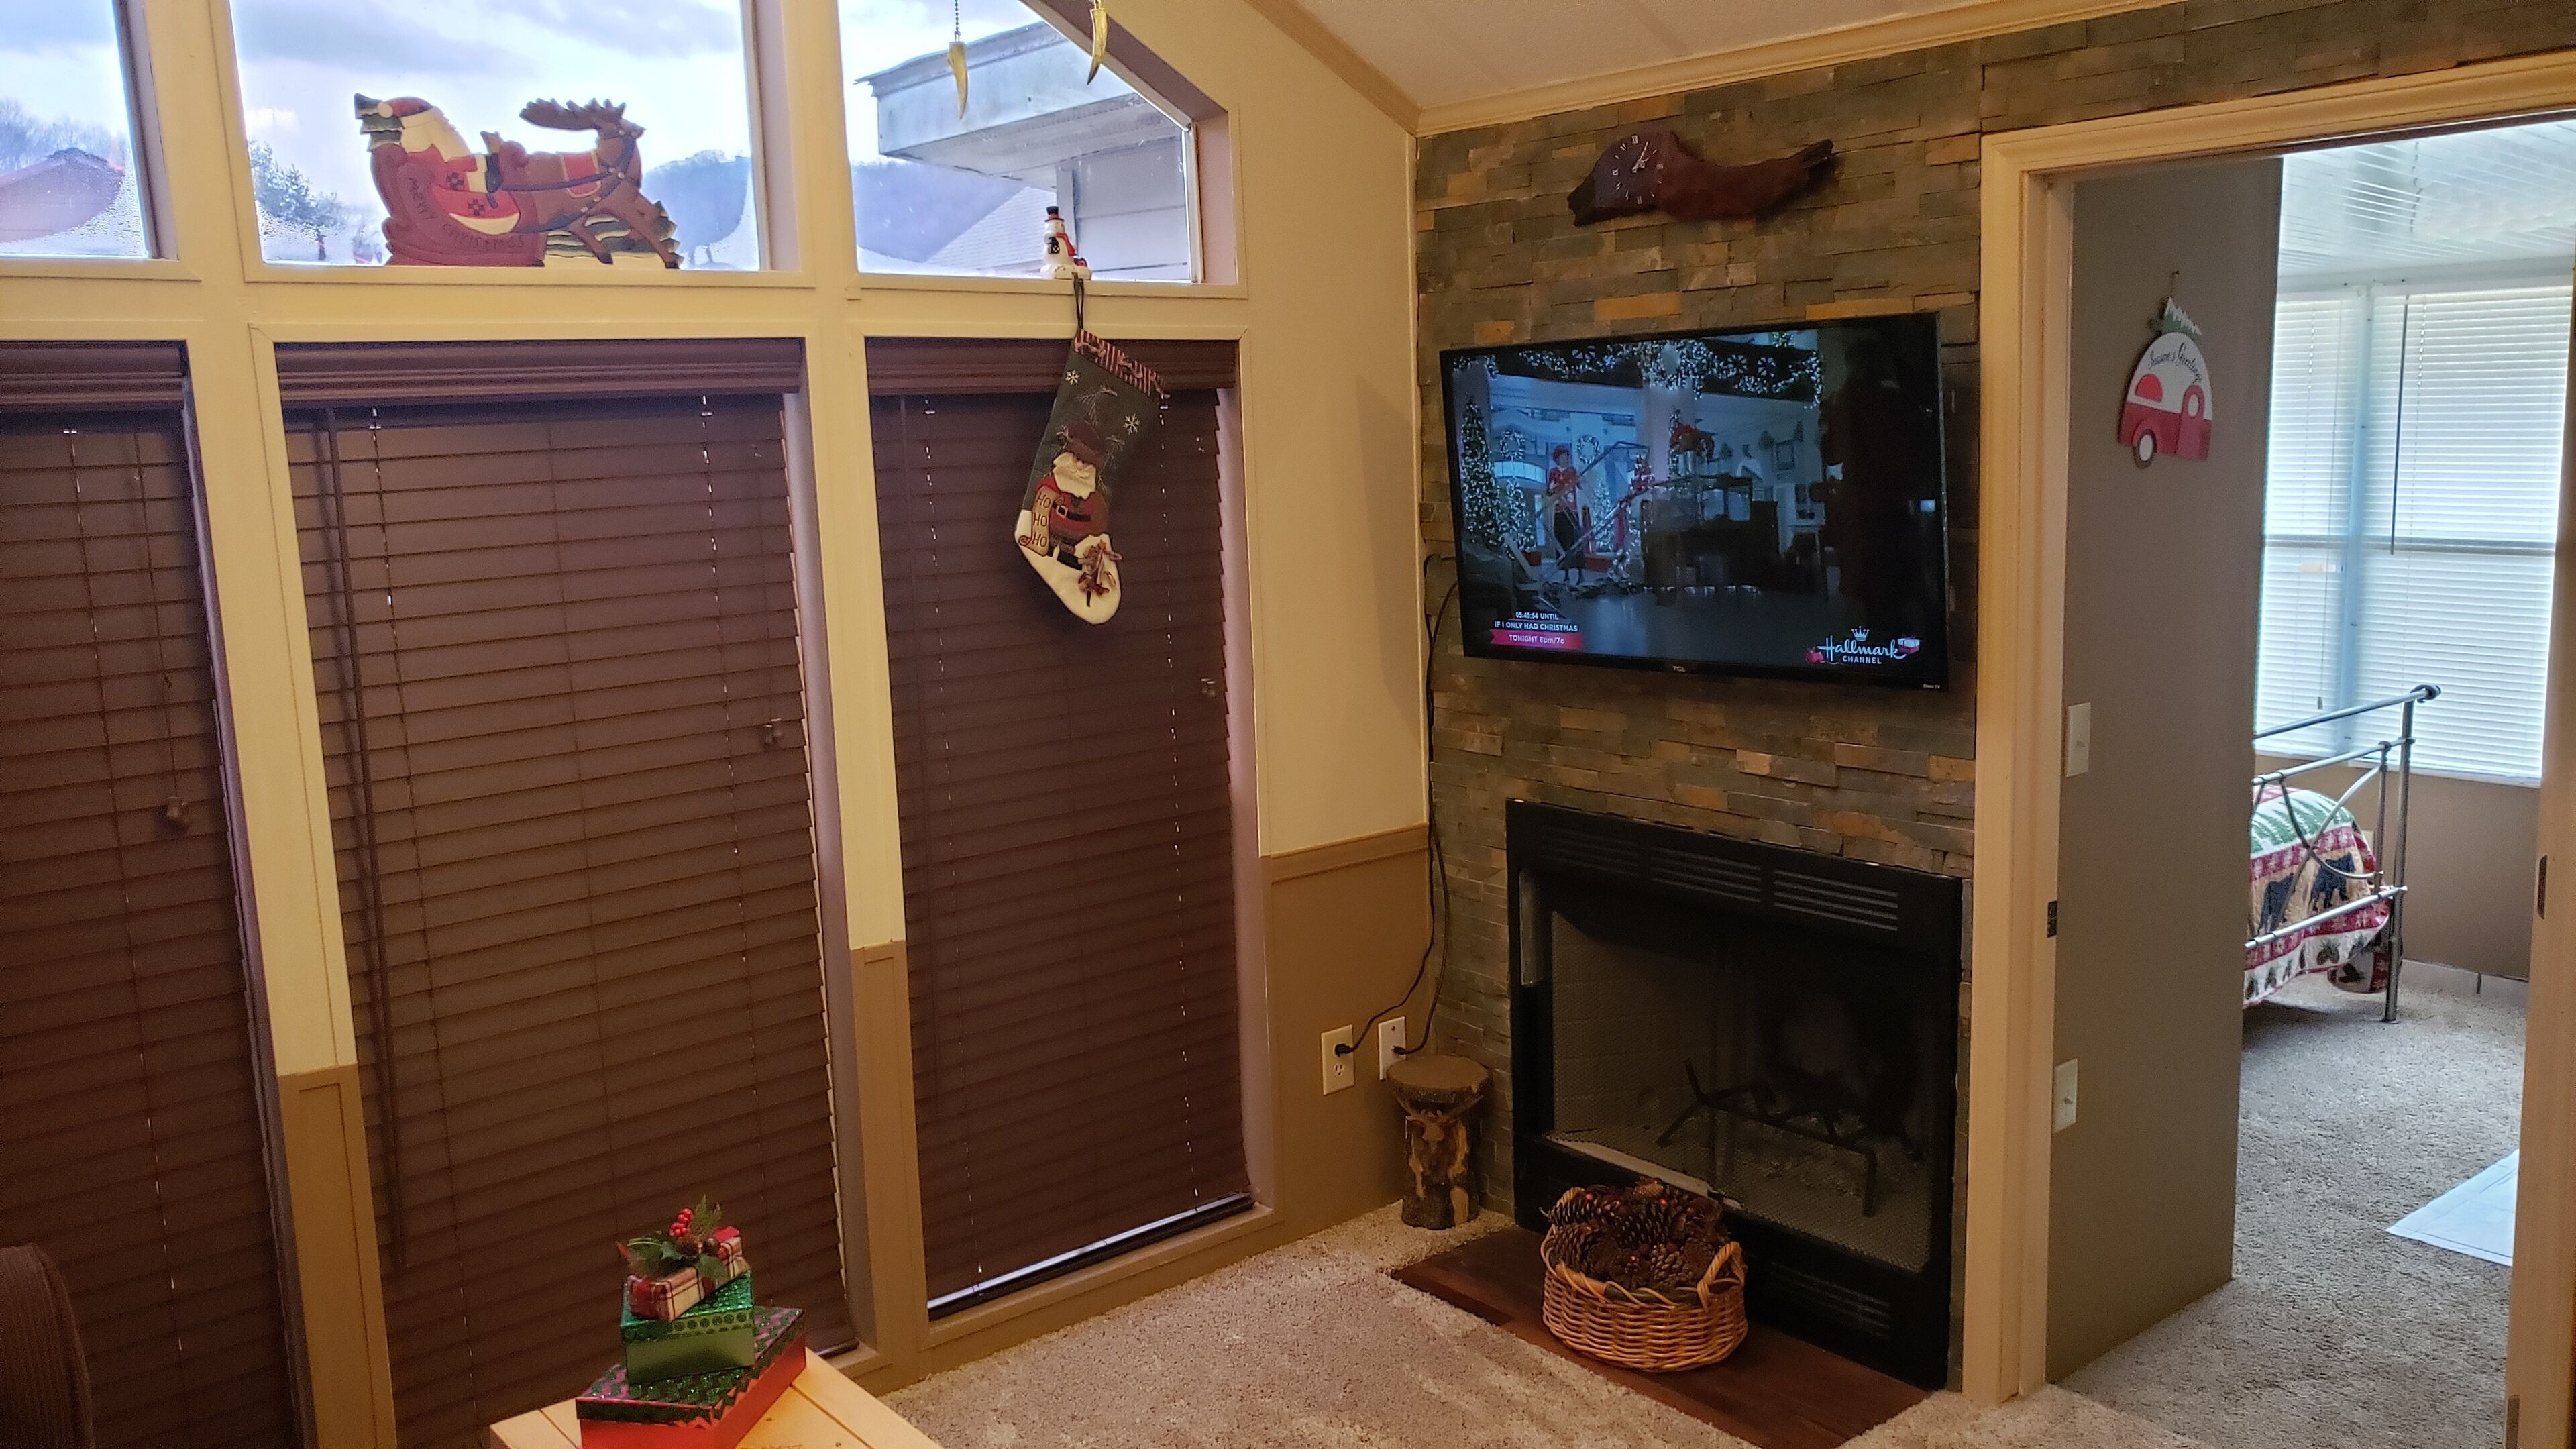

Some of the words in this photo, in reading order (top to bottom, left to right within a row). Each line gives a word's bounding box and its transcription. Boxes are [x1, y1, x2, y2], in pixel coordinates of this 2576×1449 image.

[1036, 492, 1051, 508] HO
[1033, 513, 1048, 527] HO
[1032, 533, 1047, 547] HO
[1540, 612, 1560, 621] UNTIL
[1540, 624, 1578, 632] CHRISTMAS
[1509, 634, 1538, 643] TONIGHT
[1817, 635, 1907, 662] Hallmark
[1842, 655, 1882, 665] CHANNEL
